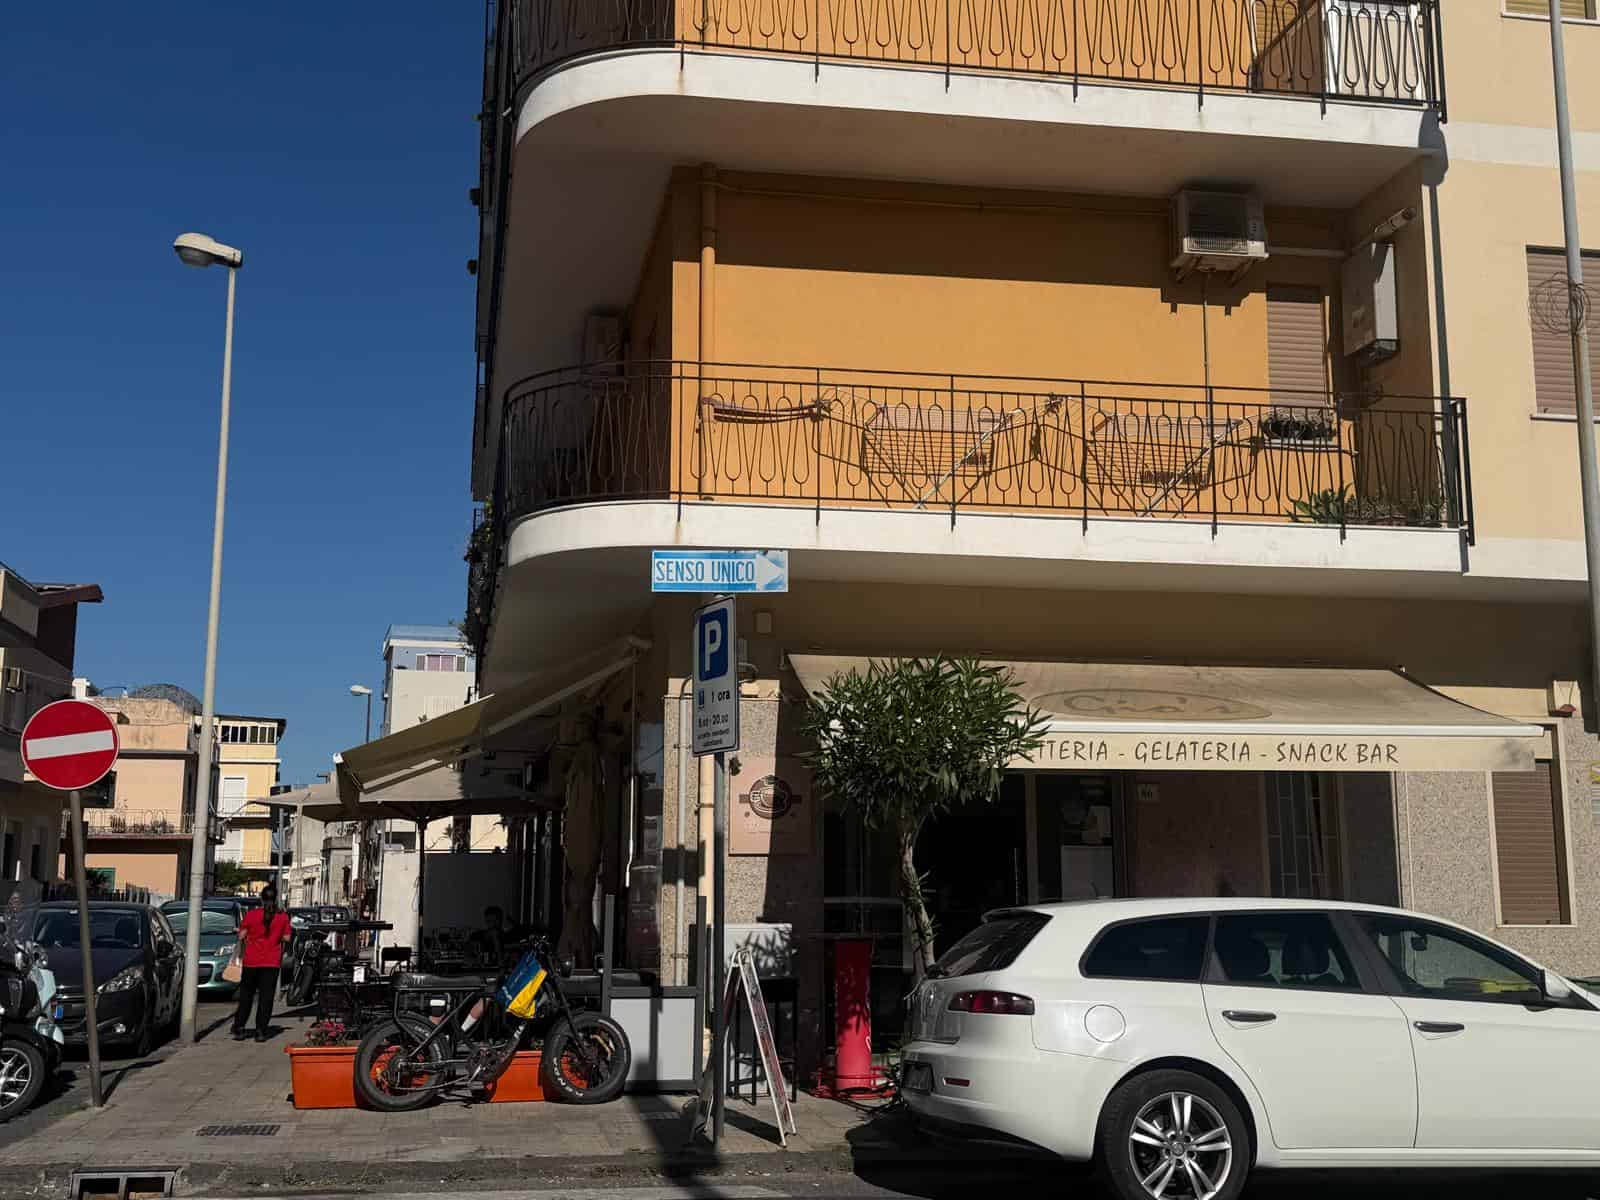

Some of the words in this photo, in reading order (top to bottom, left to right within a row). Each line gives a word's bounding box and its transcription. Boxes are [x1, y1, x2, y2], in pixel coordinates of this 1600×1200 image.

[655, 560, 705, 582] SENSO
[711, 560, 755, 583] UNICO
[704, 619, 722, 673] P
[717, 689, 731, 702] ora
[1038, 740, 1108, 761] TTERIA
[1135, 741, 1250, 763] GELATERIA
[1276, 741, 1348, 763] SNACK
[1356, 743, 1399, 764] BAR
